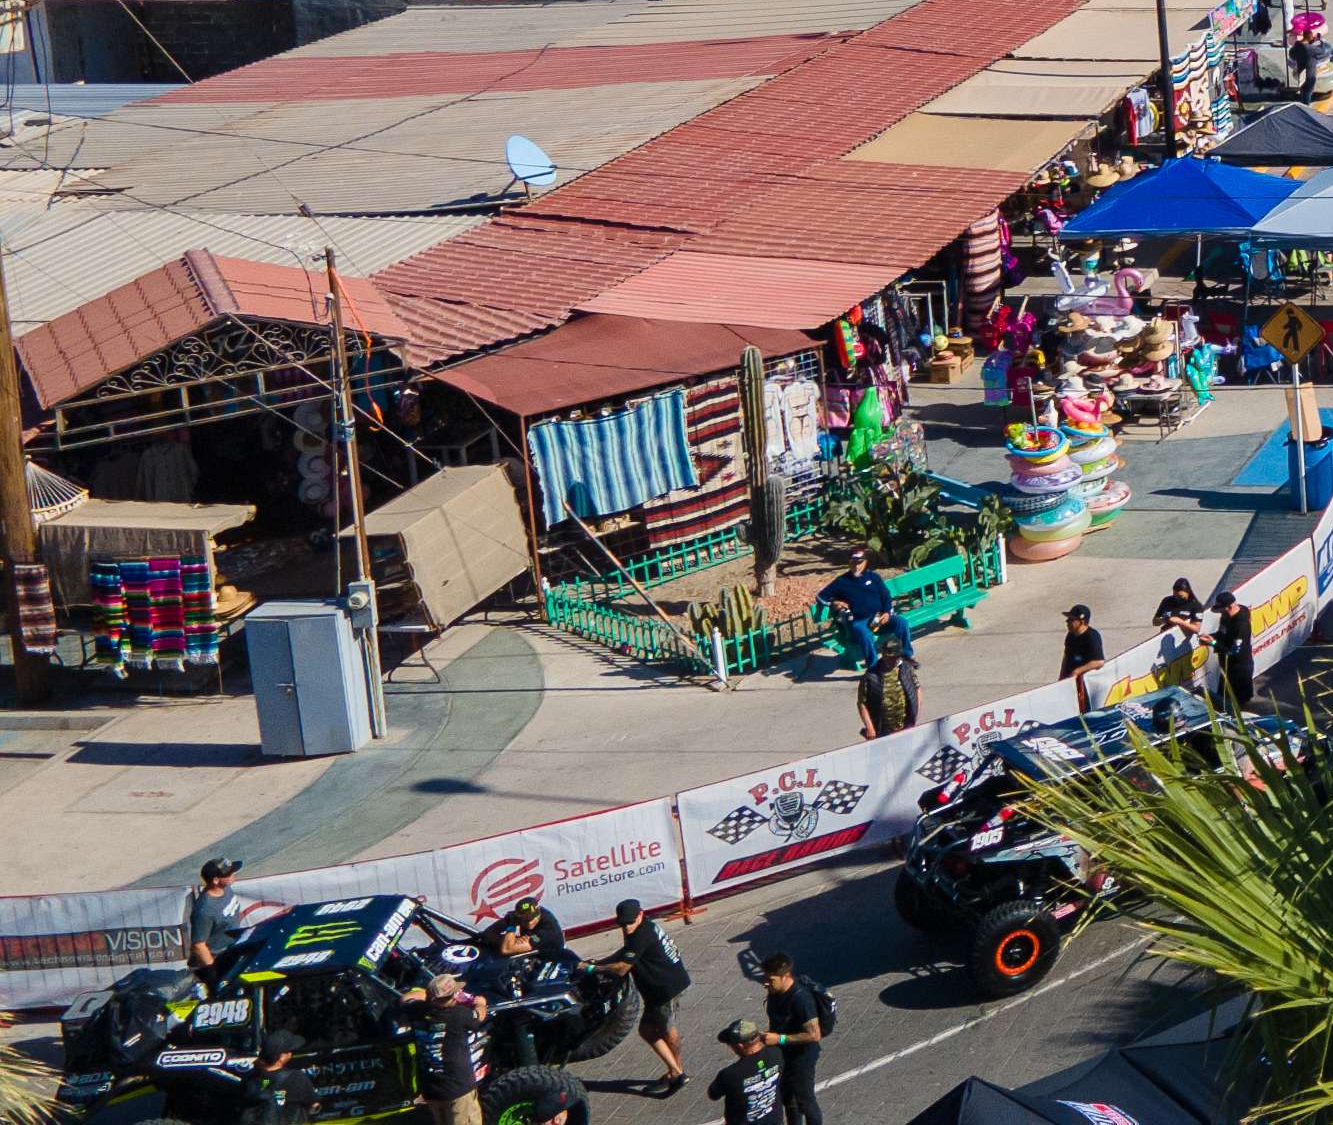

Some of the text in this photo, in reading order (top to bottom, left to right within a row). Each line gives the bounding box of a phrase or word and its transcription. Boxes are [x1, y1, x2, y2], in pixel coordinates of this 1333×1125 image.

[952, 708, 1020, 745] P.C.I.
[749, 769, 822, 806] P.C.I.
[554, 840, 662, 881] Satellite
[557, 860, 666, 896] PhoneStore.com
[194, 999, 251, 1028] 2948
[162, 1052, 223, 1064] COGNITO
